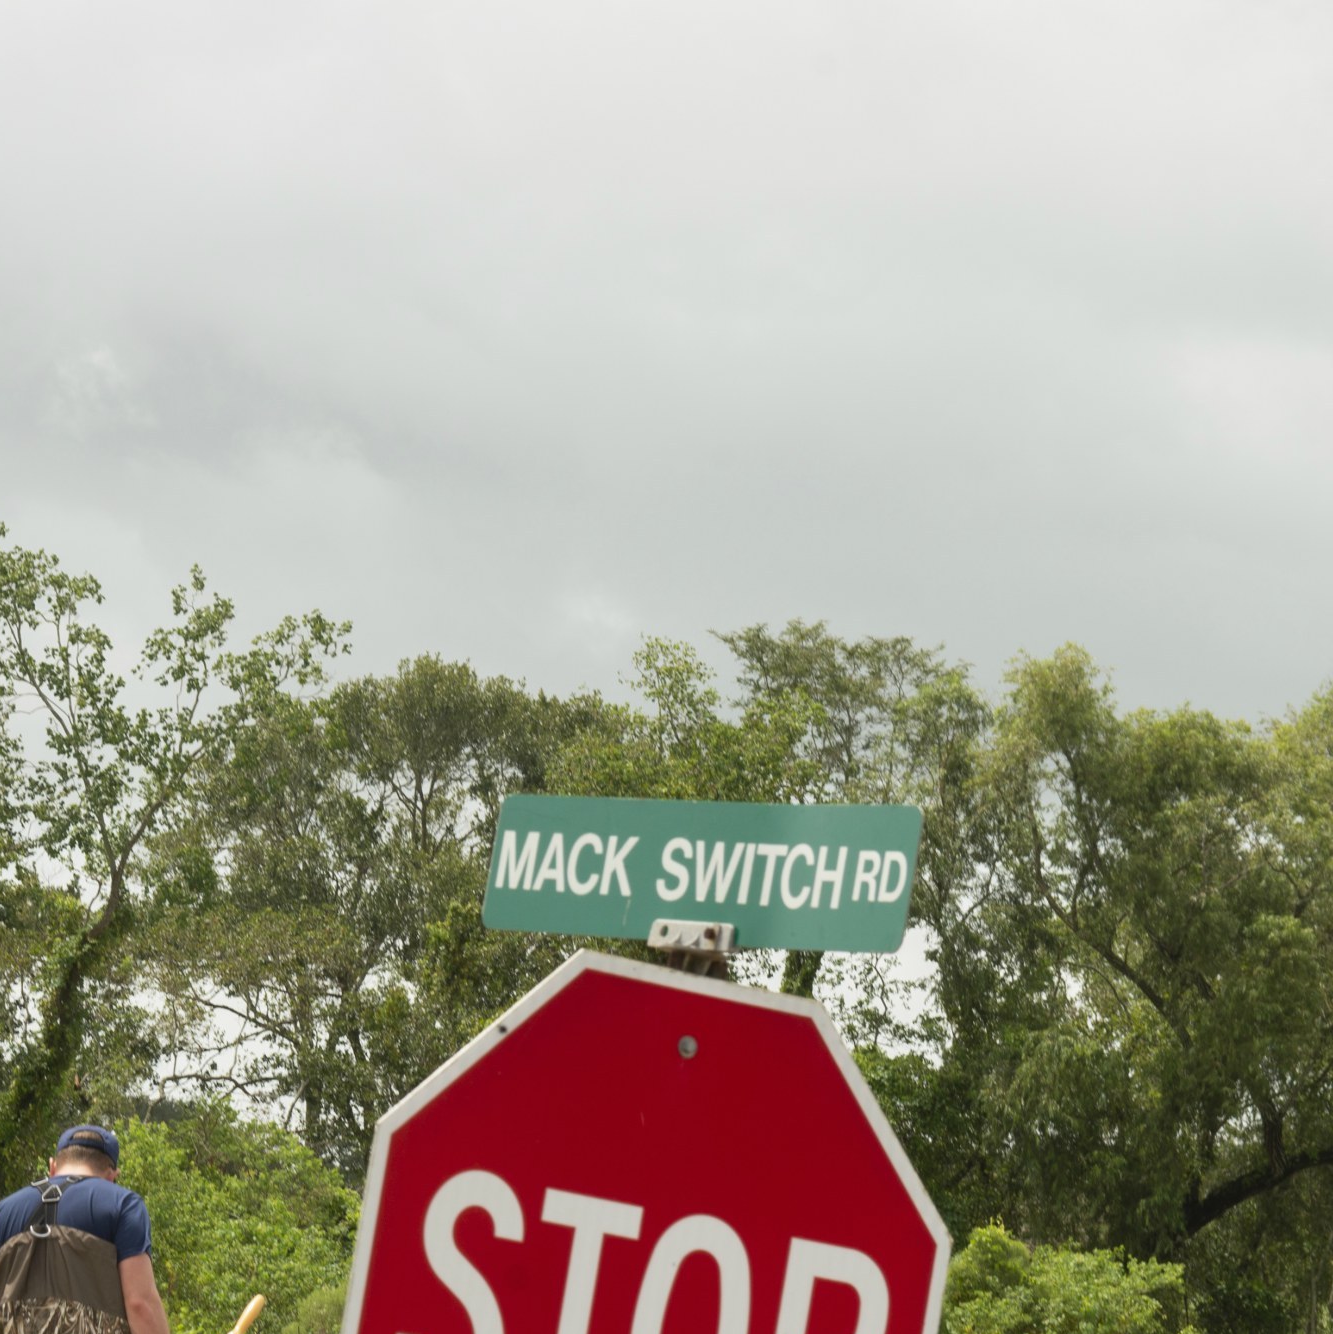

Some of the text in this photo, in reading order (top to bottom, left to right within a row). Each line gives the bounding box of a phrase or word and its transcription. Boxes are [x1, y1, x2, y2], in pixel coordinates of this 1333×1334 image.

[494, 829, 909, 910] MACK SWITCH RD
